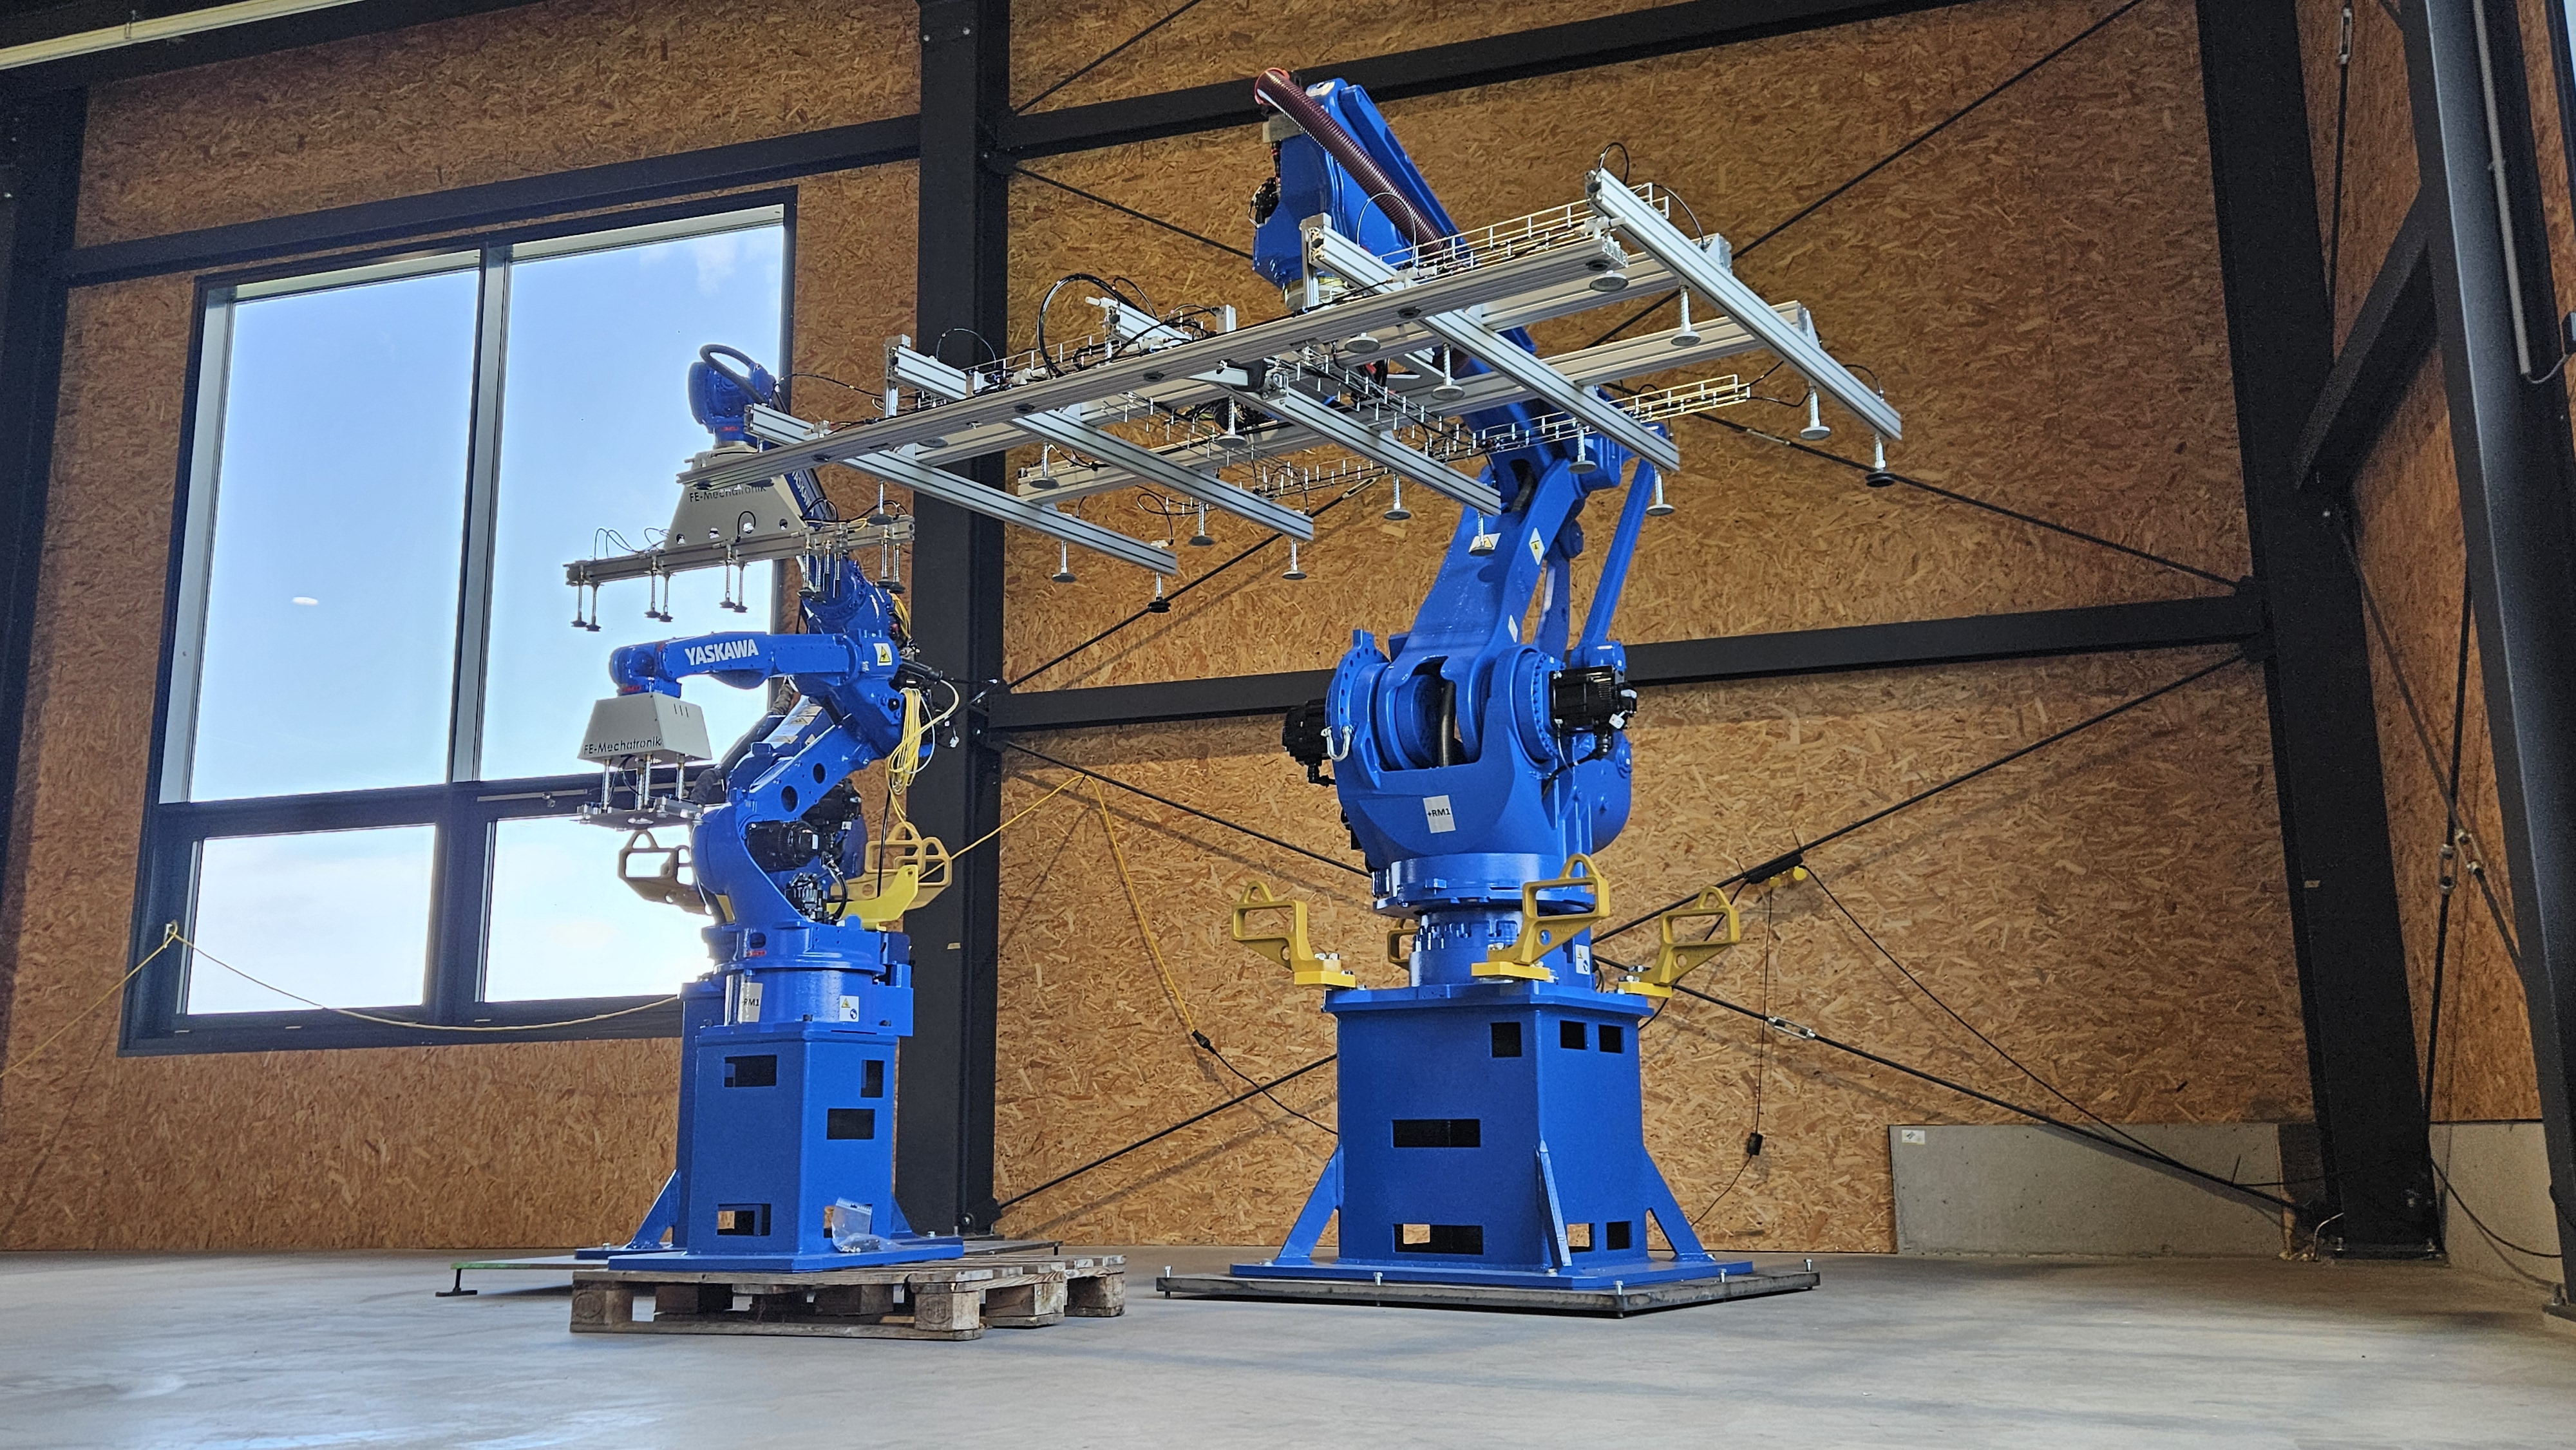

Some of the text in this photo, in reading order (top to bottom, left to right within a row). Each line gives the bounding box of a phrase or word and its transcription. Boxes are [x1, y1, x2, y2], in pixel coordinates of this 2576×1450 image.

[685, 639, 759, 666] YASKAWA
[583, 736, 662, 755] FE-Mechatronik
[1427, 808, 1450, 816] +RM1
